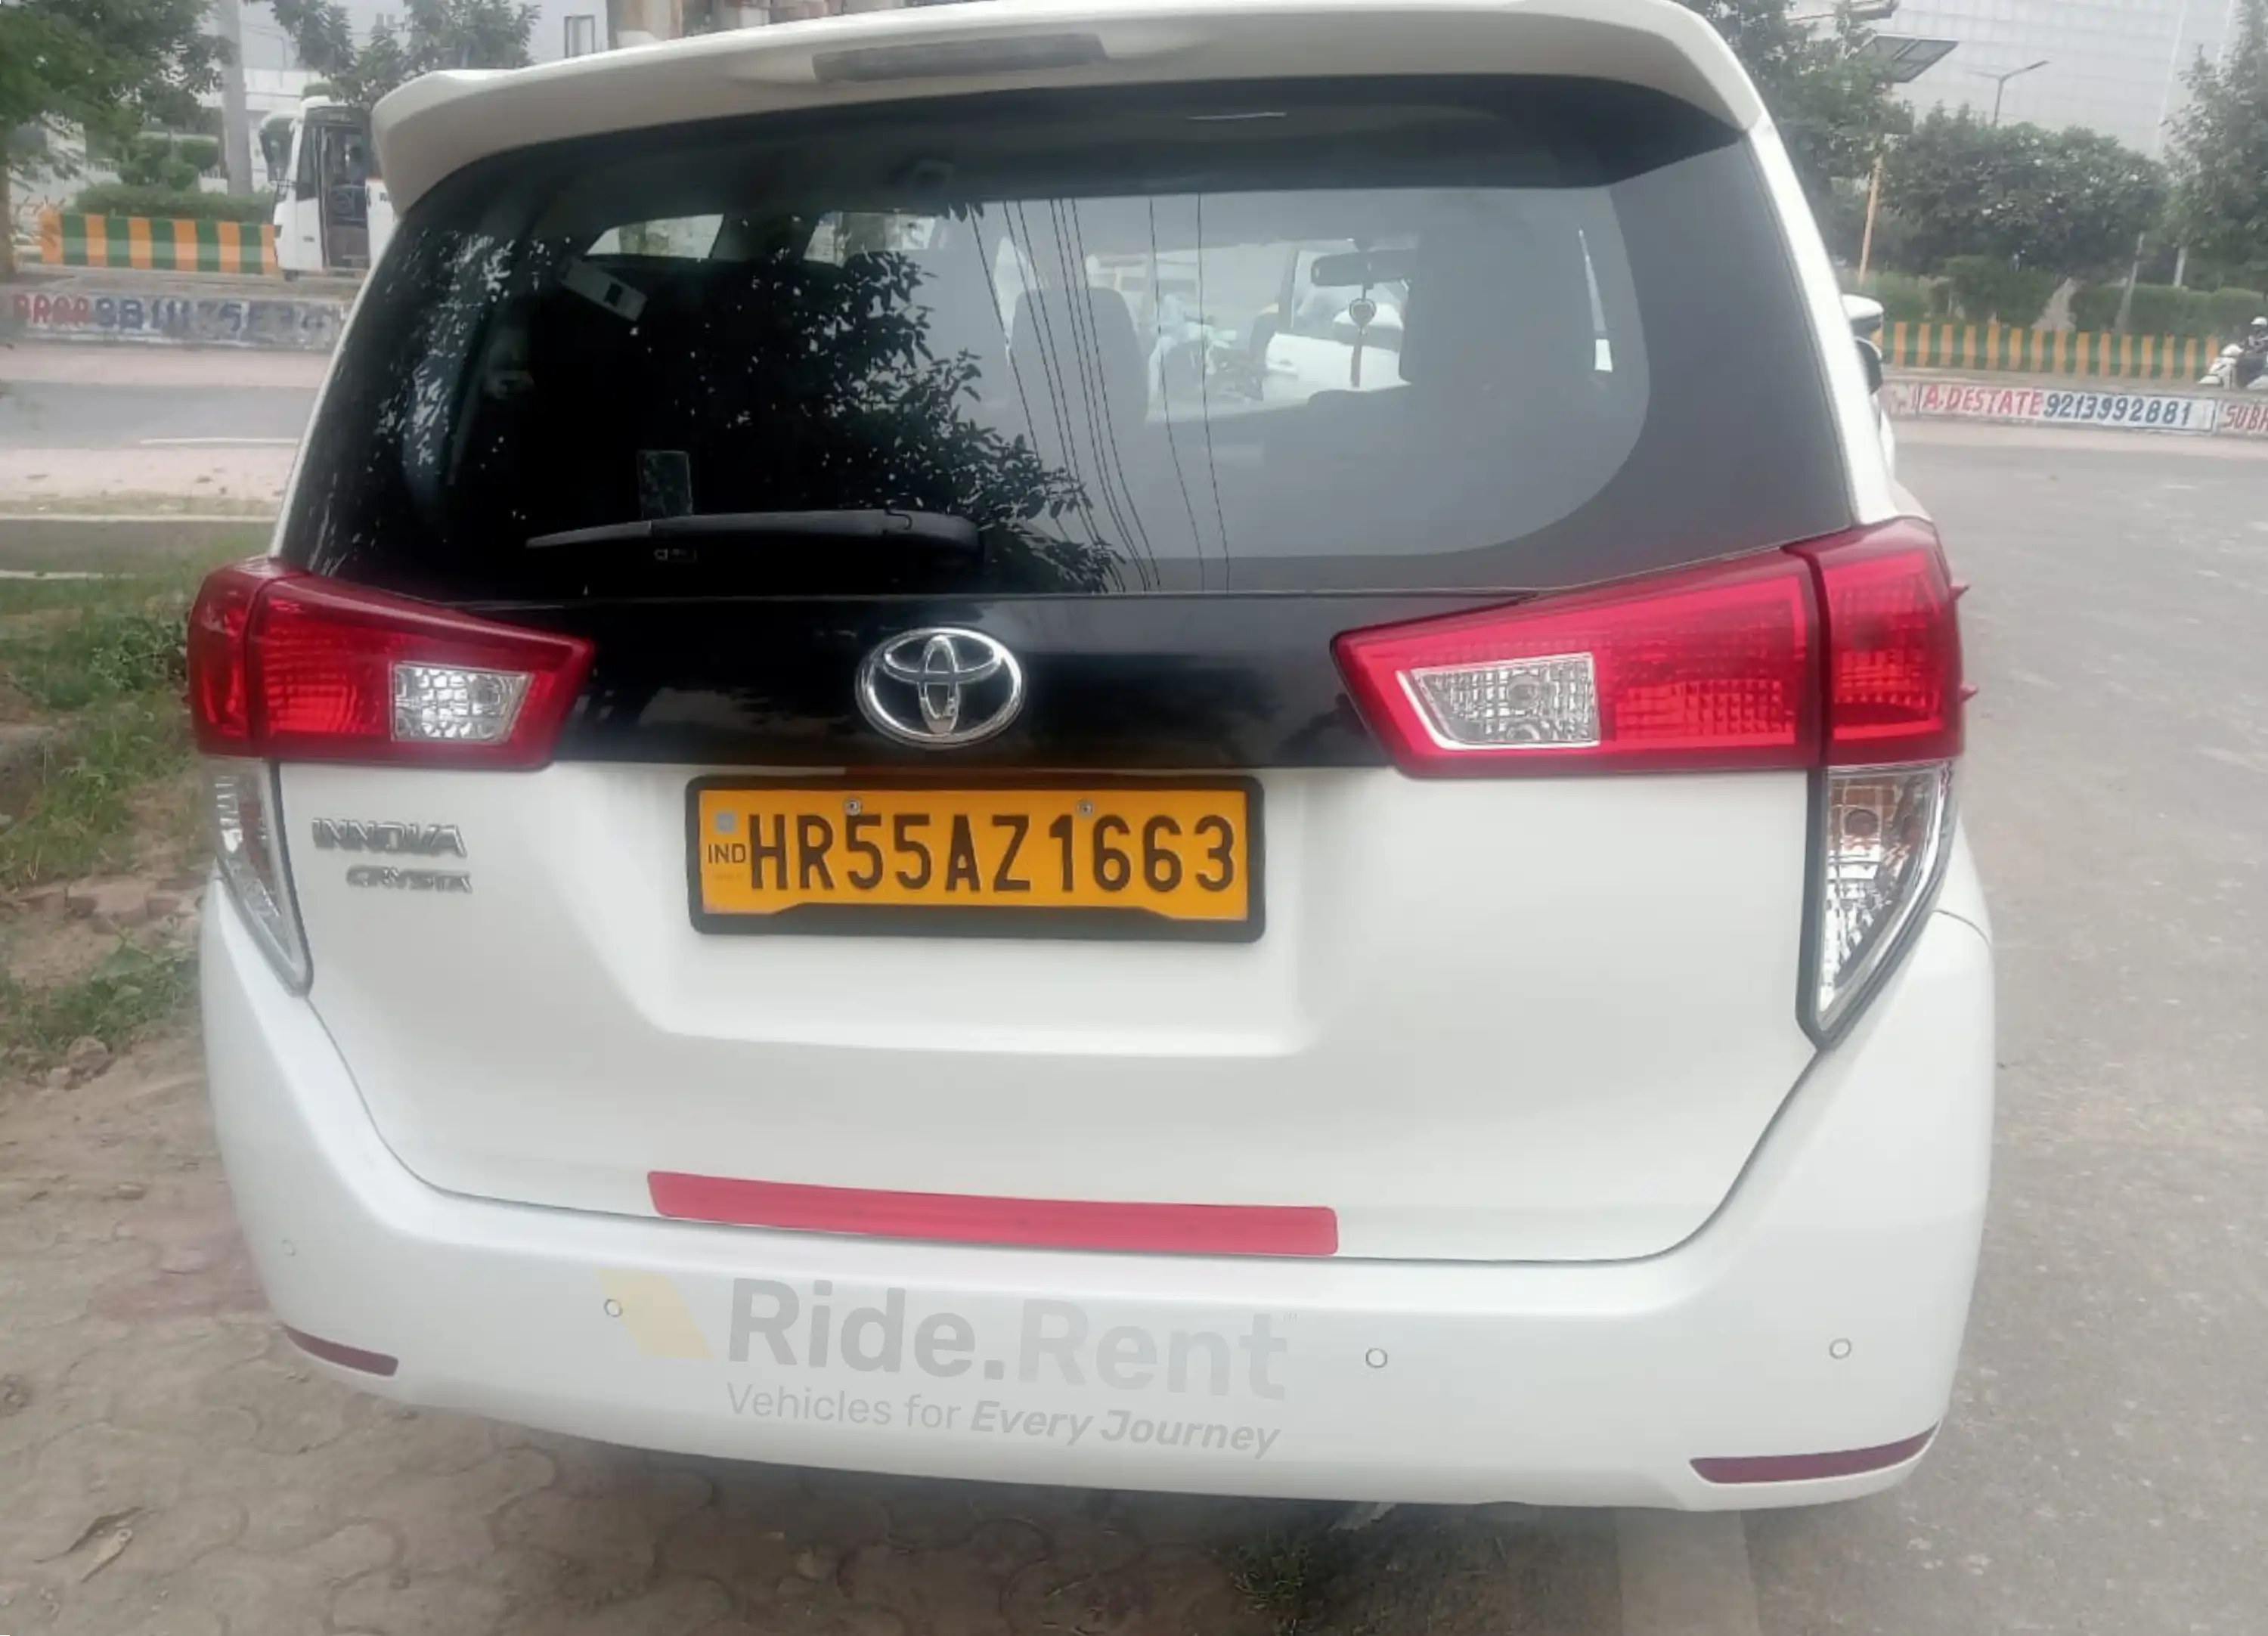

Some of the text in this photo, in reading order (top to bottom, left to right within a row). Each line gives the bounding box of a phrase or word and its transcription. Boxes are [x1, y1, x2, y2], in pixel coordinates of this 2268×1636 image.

[2043, 393, 2192, 426] 9213992881
[311, 817, 468, 858] INNOVA
[708, 843, 746, 864] IND
[748, 813, 1235, 892] HR55AZ1663
